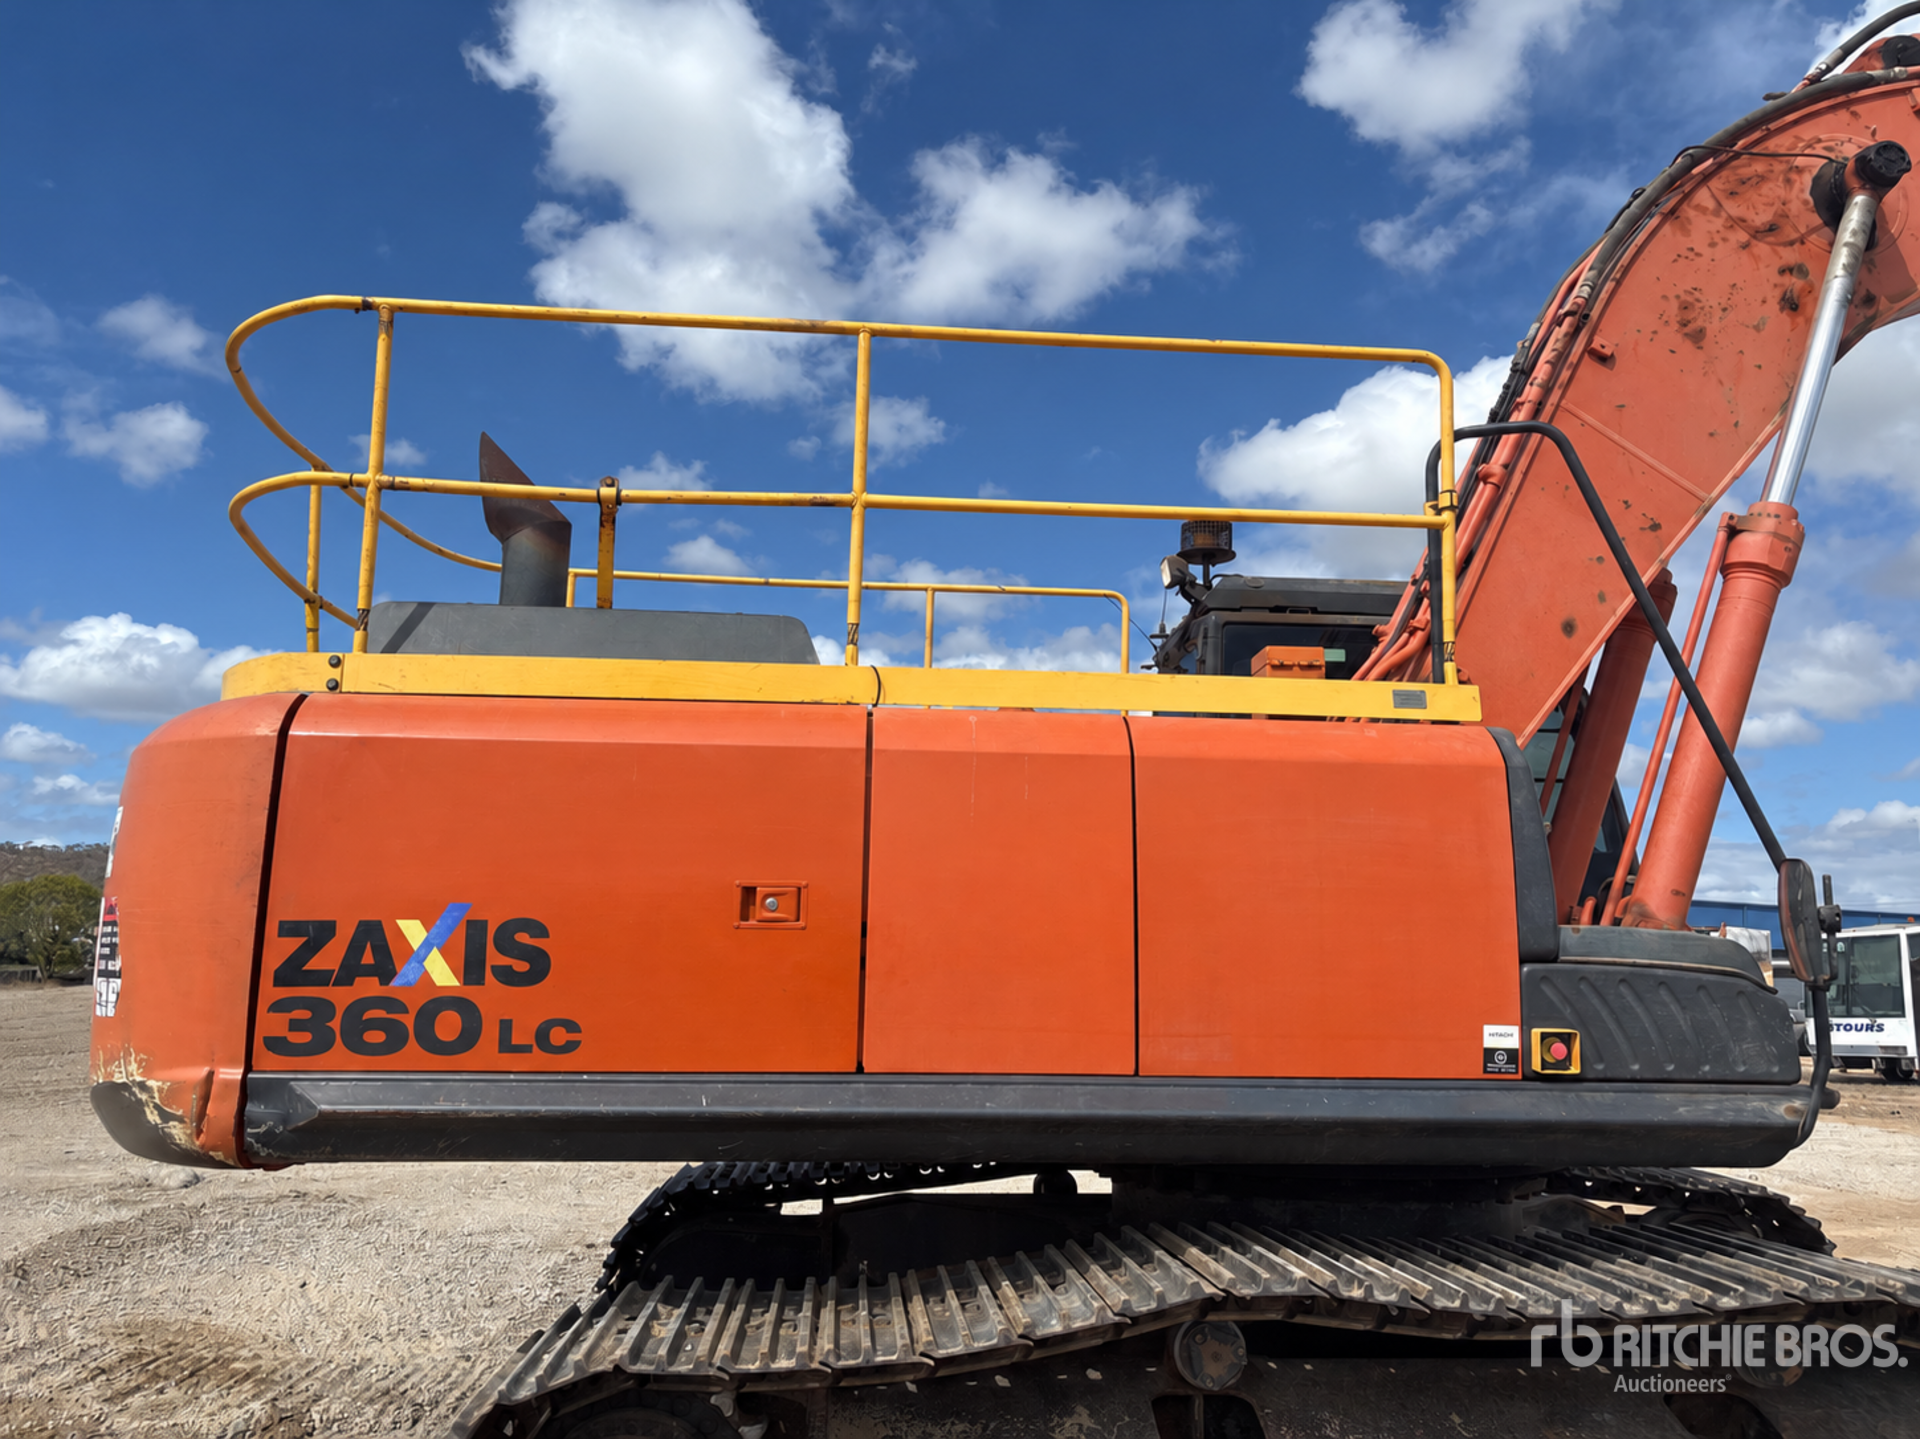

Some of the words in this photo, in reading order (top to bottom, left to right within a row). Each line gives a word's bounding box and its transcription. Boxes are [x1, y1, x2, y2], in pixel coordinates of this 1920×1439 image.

[273, 902, 552, 987] ZAXIS
[262, 995, 483, 1058] 360
[498, 1017, 583, 1055] LC
